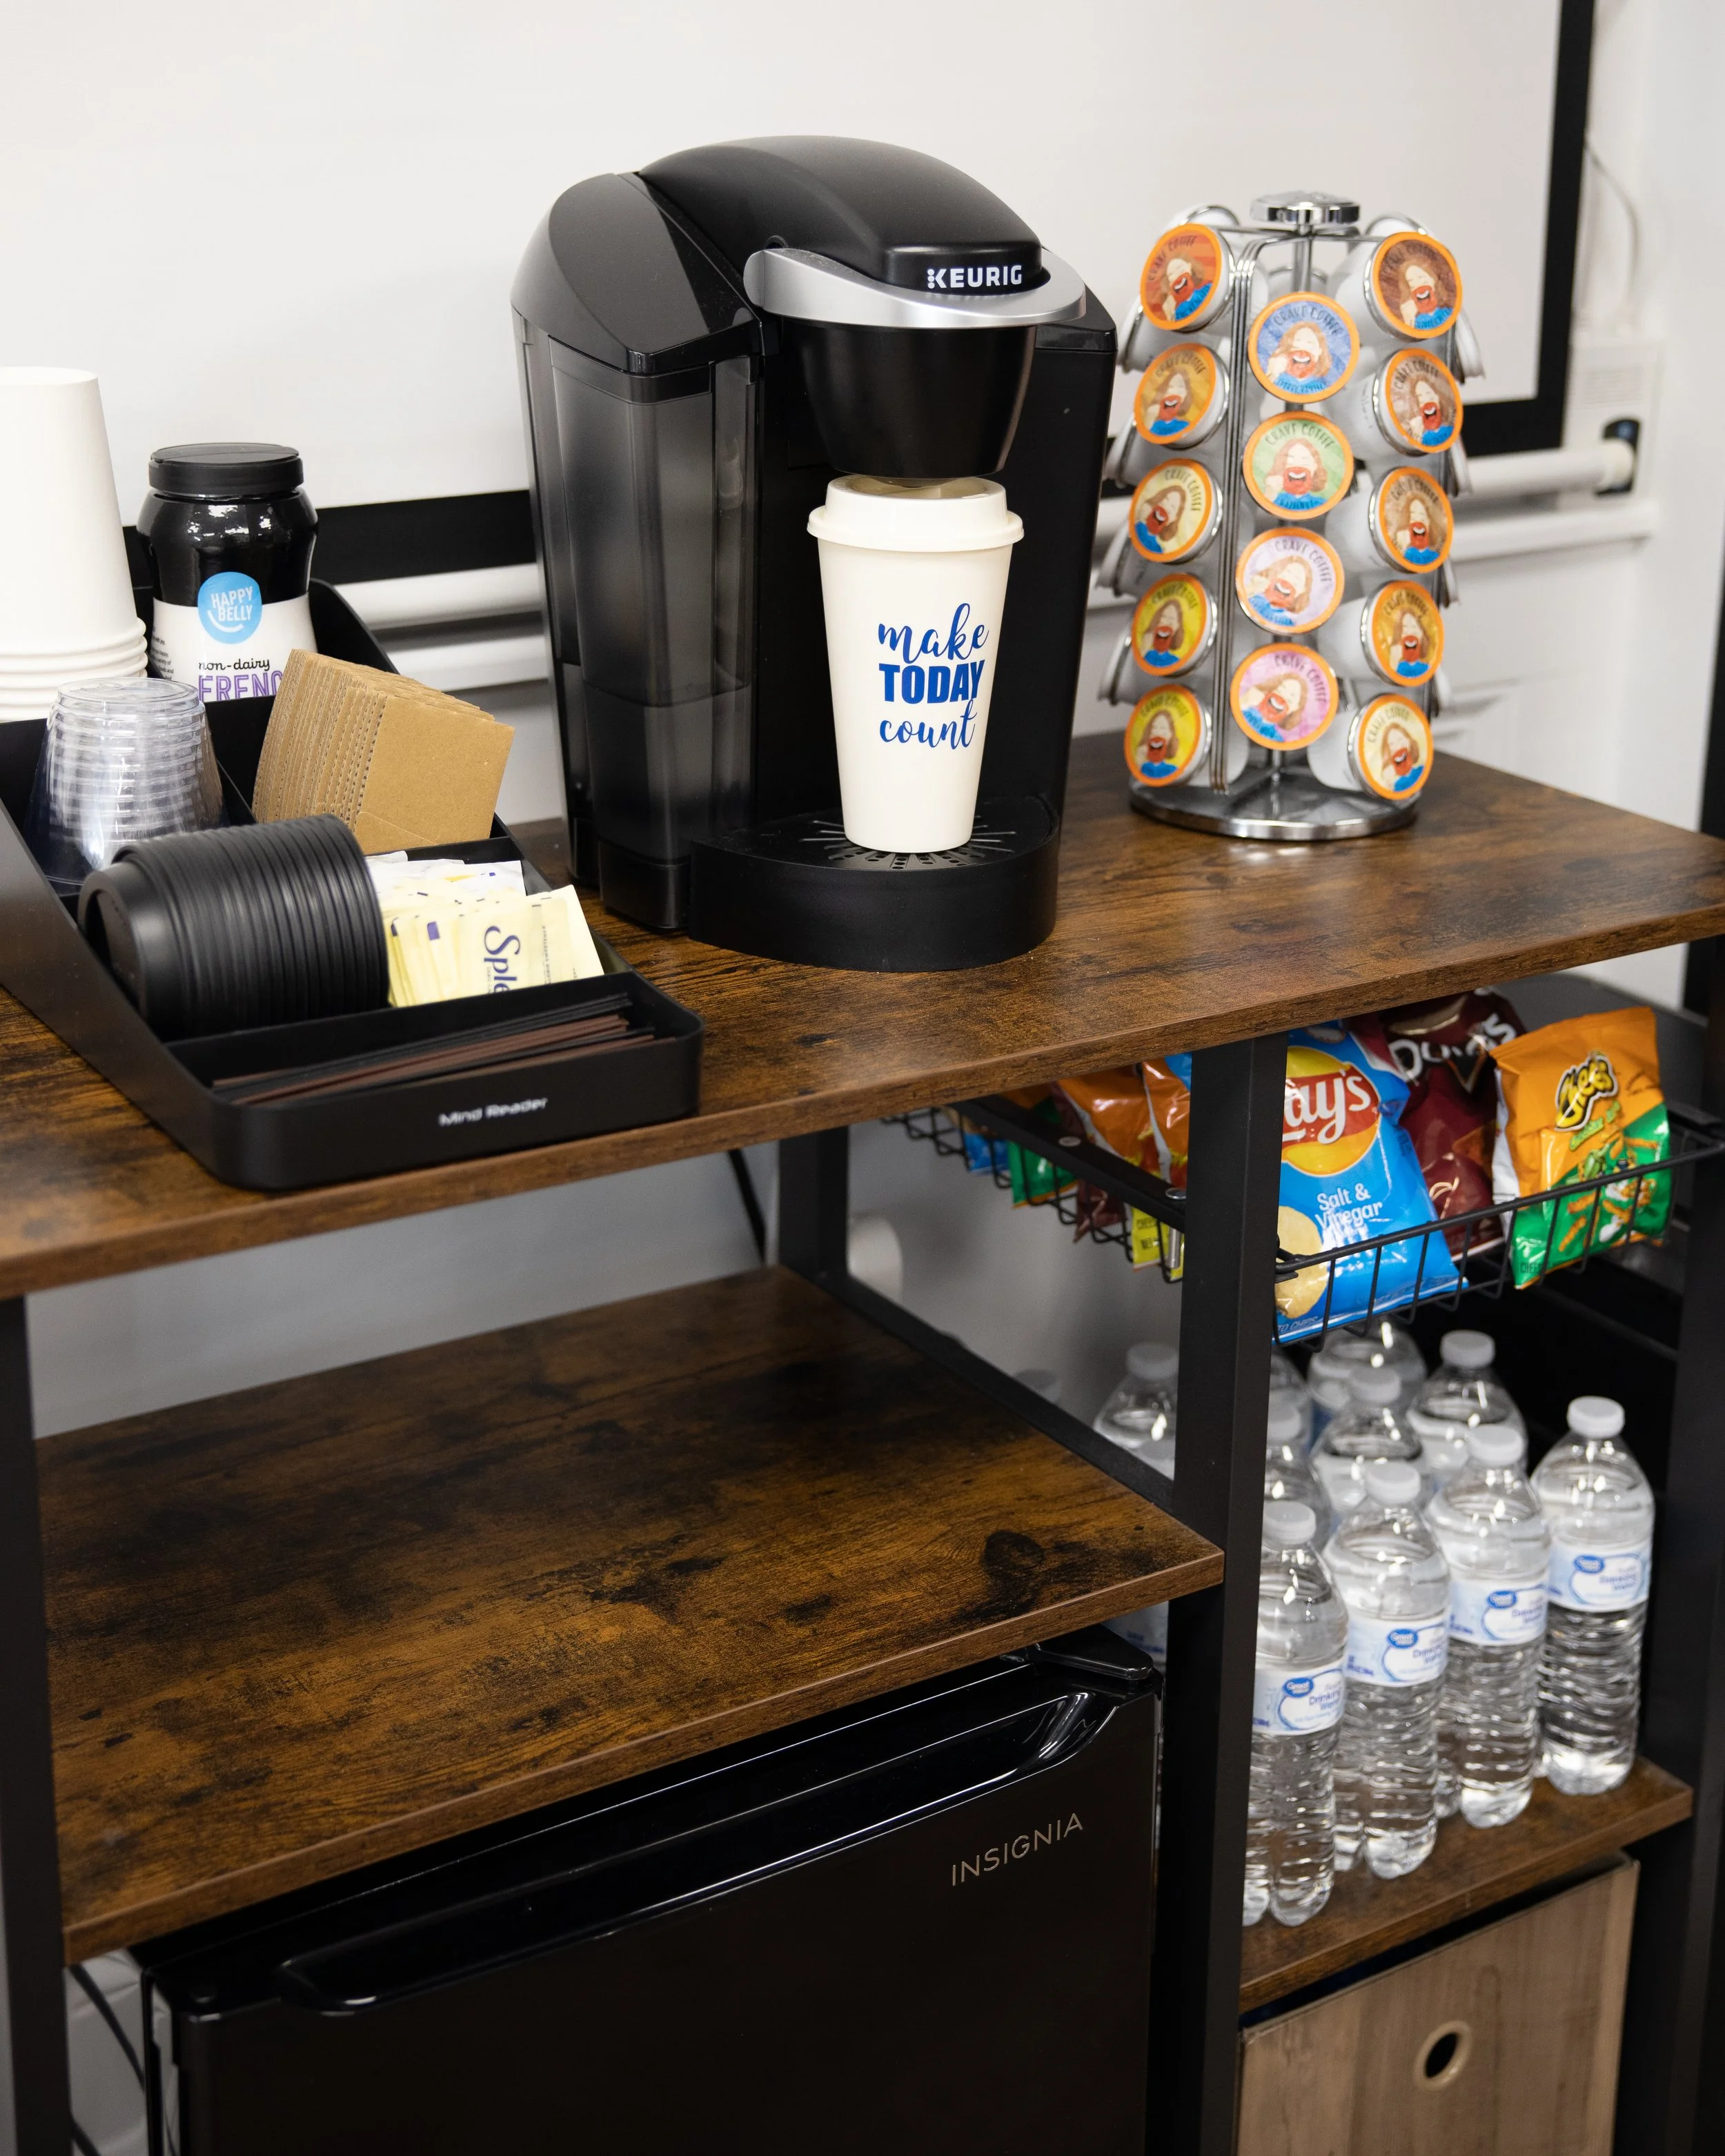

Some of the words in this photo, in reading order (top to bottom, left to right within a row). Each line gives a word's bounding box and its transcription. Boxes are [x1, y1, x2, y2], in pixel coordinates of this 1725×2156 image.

[927, 265, 1022, 288] KEURIG
[211, 586, 253, 609] HAPPY
[218, 604, 253, 622] BELLY
[878, 603, 989, 664] make
[199, 658, 270, 671] non-dairy
[199, 670, 283, 702] FRENC
[879, 660, 985, 704] TODAY
[880, 699, 977, 750] count
[484, 926, 520, 993] Sple
[439, 1108, 483, 1127] Mind
[486, 1098, 548, 1118] Reader
[1282, 1069, 1371, 1145] ay's
[1317, 1187, 1352, 1210] Salt
[1354, 1183, 1371, 1201] &
[1315, 1201, 1383, 1231] Vinegar
[952, 1813, 1083, 1886] INSIGNIA
